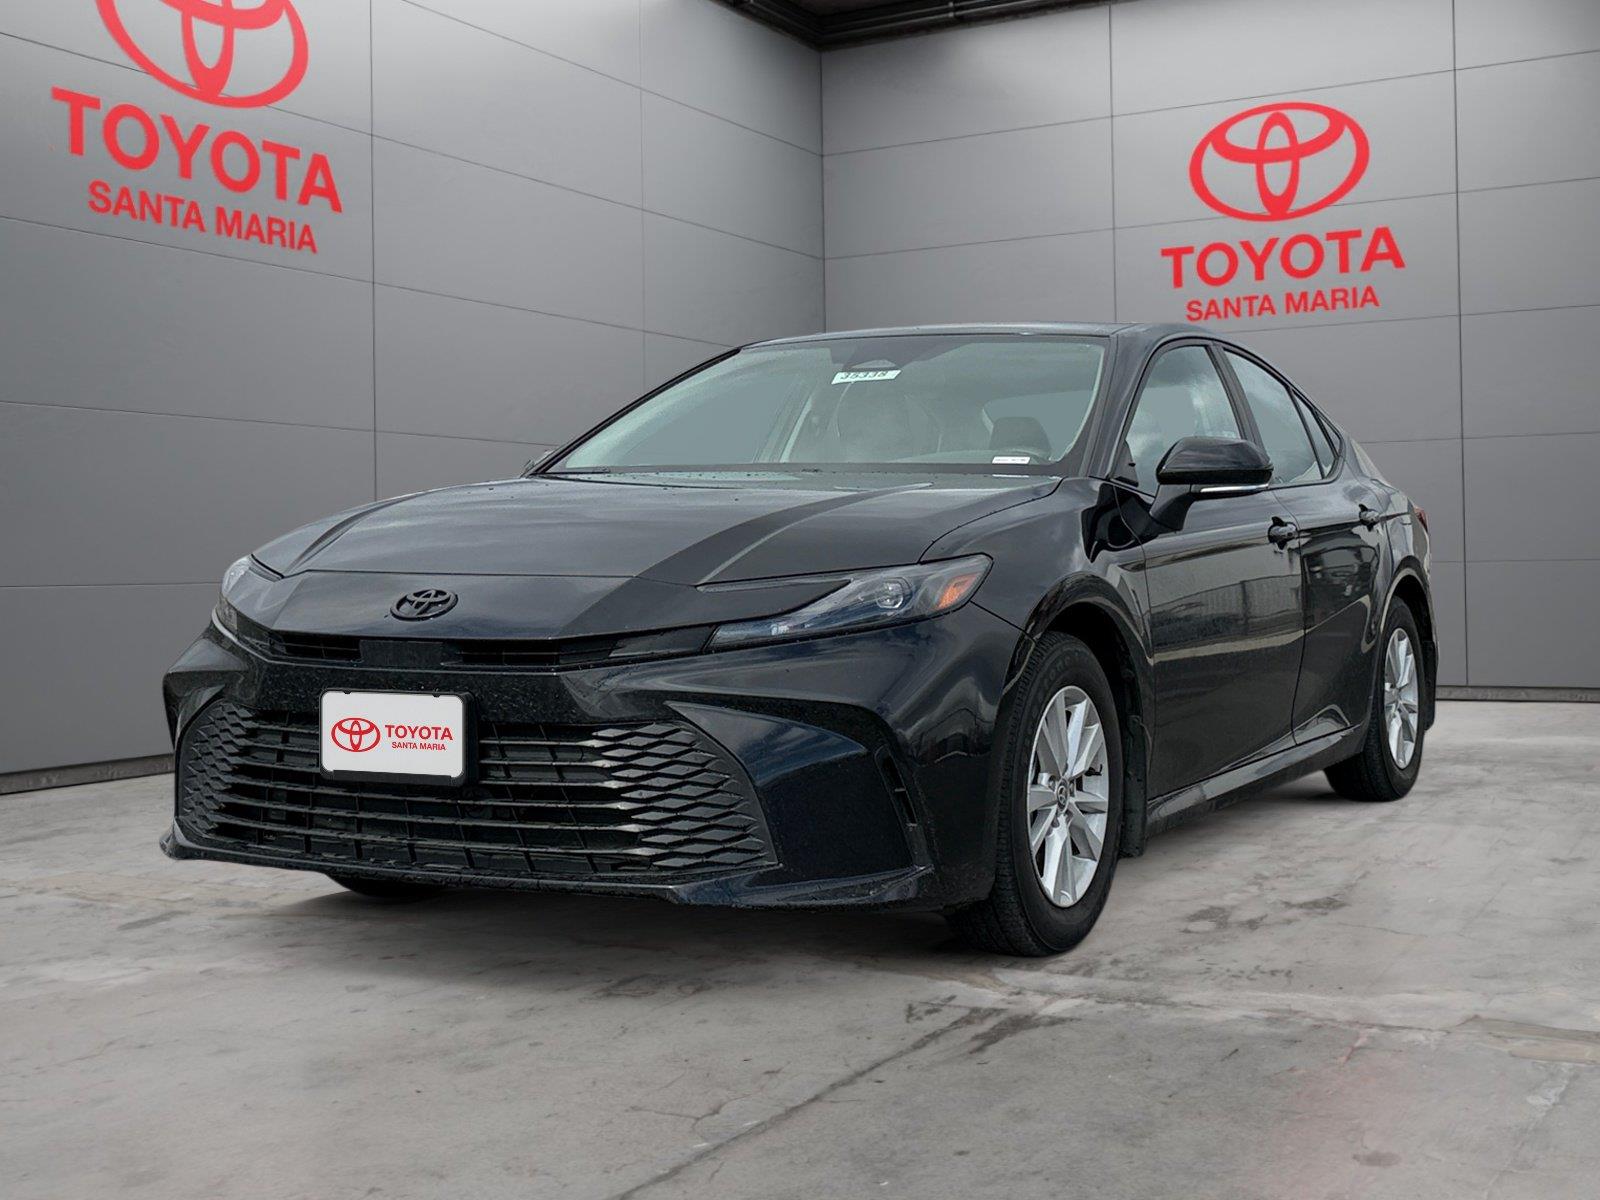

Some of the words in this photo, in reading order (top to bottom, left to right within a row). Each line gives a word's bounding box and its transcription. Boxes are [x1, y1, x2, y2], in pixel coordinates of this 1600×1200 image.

[51, 86, 343, 214] TOYOTA
[87, 180, 206, 233] SANTA
[215, 206, 318, 254] MARIA
[1160, 226, 1406, 289] TOYOTA
[1186, 294, 1276, 322] SANTA
[1285, 286, 1380, 314] MARIA
[385, 725, 453, 741] TOYOTA
[391, 742, 417, 750] SANTA
[420, 743, 446, 751] MARIA
